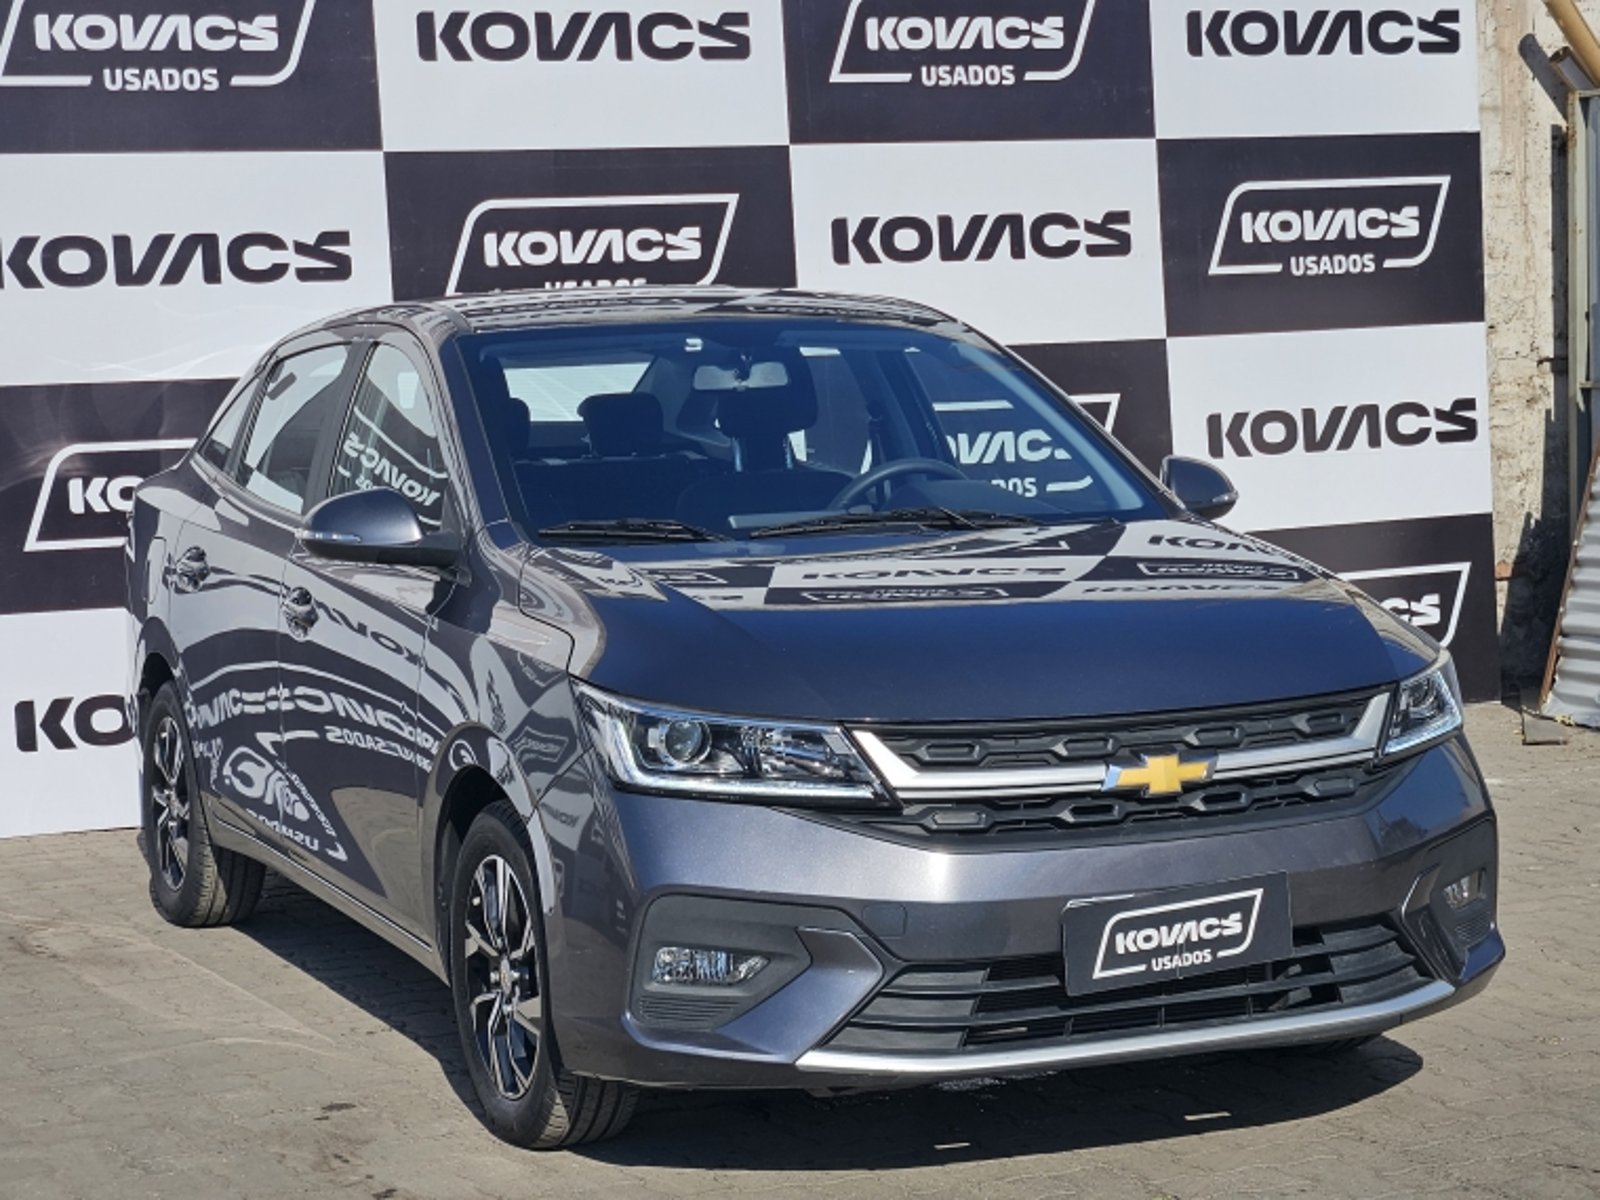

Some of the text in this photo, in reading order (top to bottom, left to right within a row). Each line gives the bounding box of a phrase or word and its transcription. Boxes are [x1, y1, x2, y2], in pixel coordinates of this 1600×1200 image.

[33, 13, 279, 52] KOVACS
[416, 11, 751, 62] KOVACS
[865, 16, 1065, 51] KOVACS
[1186, 9, 1460, 57] KOVACS
[102, 67, 220, 91] USADOS
[920, 64, 1016, 87] USADOS
[831, 210, 1132, 265] KOVACS
[1240, 205, 1420, 243] KOVACS
[0, 230, 353, 290] KOVACS
[483, 226, 702, 268] KOVACS
[1290, 253, 1376, 277] USADOS
[945, 428, 1073, 465] VAC
[1206, 397, 1478, 459] KOVACS
[1114, 910, 1243, 955] KOVACS
[1151, 948, 1213, 972] USADOS
